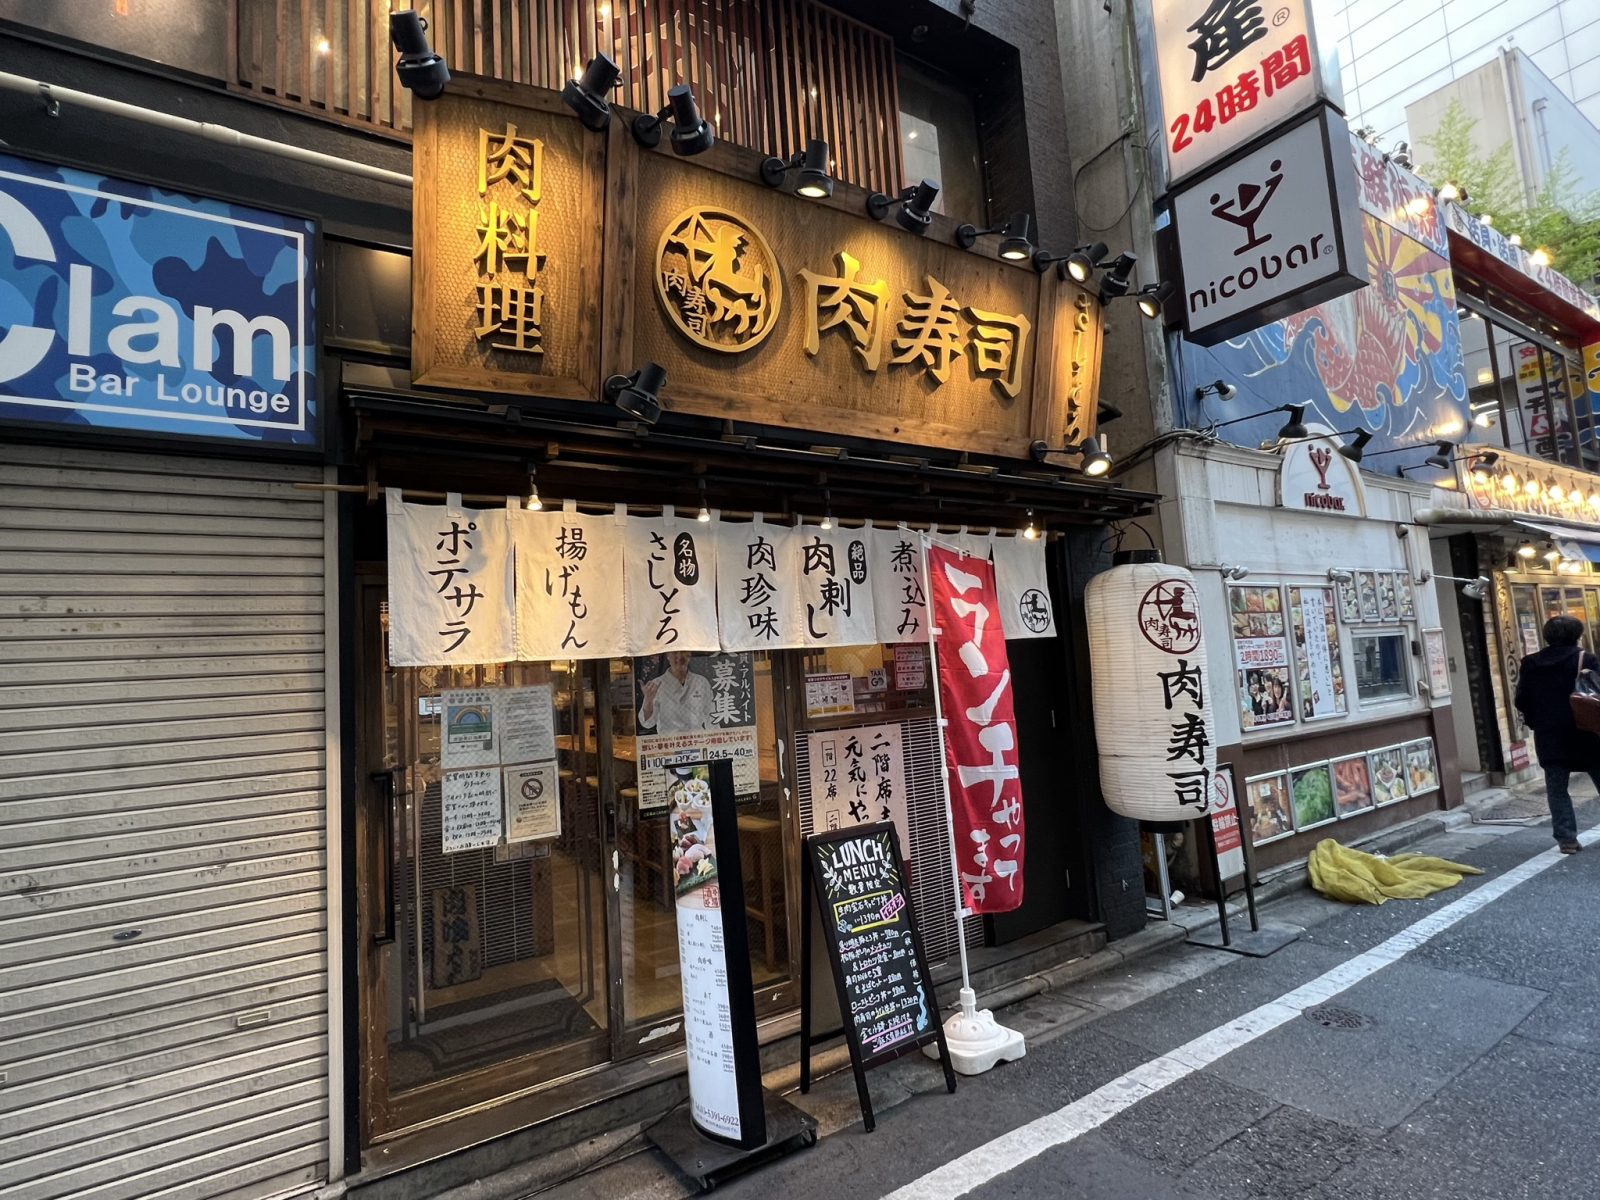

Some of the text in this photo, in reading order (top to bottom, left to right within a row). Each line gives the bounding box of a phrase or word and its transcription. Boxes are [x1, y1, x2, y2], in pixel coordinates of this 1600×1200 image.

[1170, 34, 1311, 153] 24時間
[473, 122, 547, 354] 肉料理
[1190, 233, 1324, 313] nicobar
[663, 268, 707, 338] 肉寿司
[798, 251, 1032, 398] 肉寿司
[69, 363, 291, 414] Bar Lounge
[428, 521, 484, 652] ポテサラ
[546, 526, 588, 650] 揚げもん
[647, 531, 681, 644] さしとろ
[677, 539, 696, 578] 名物
[740, 536, 780, 641] 肉珍味
[802, 536, 852, 639] 肉刺し
[850, 543, 865, 580] 絶品
[891, 540, 926, 636] 煮込み
[1144, 617, 1174, 650] 肉寿司
[710, 650, 742, 725] 募集
[944, 562, 1019, 811] ランチ
[1157, 659, 1210, 812] 肉寿司
[824, 768, 837, 801] 22席
[831, 839, 884, 869] LUNCH
[843, 863, 877, 882] MENU
[848, 879, 882, 895] 数量限定
